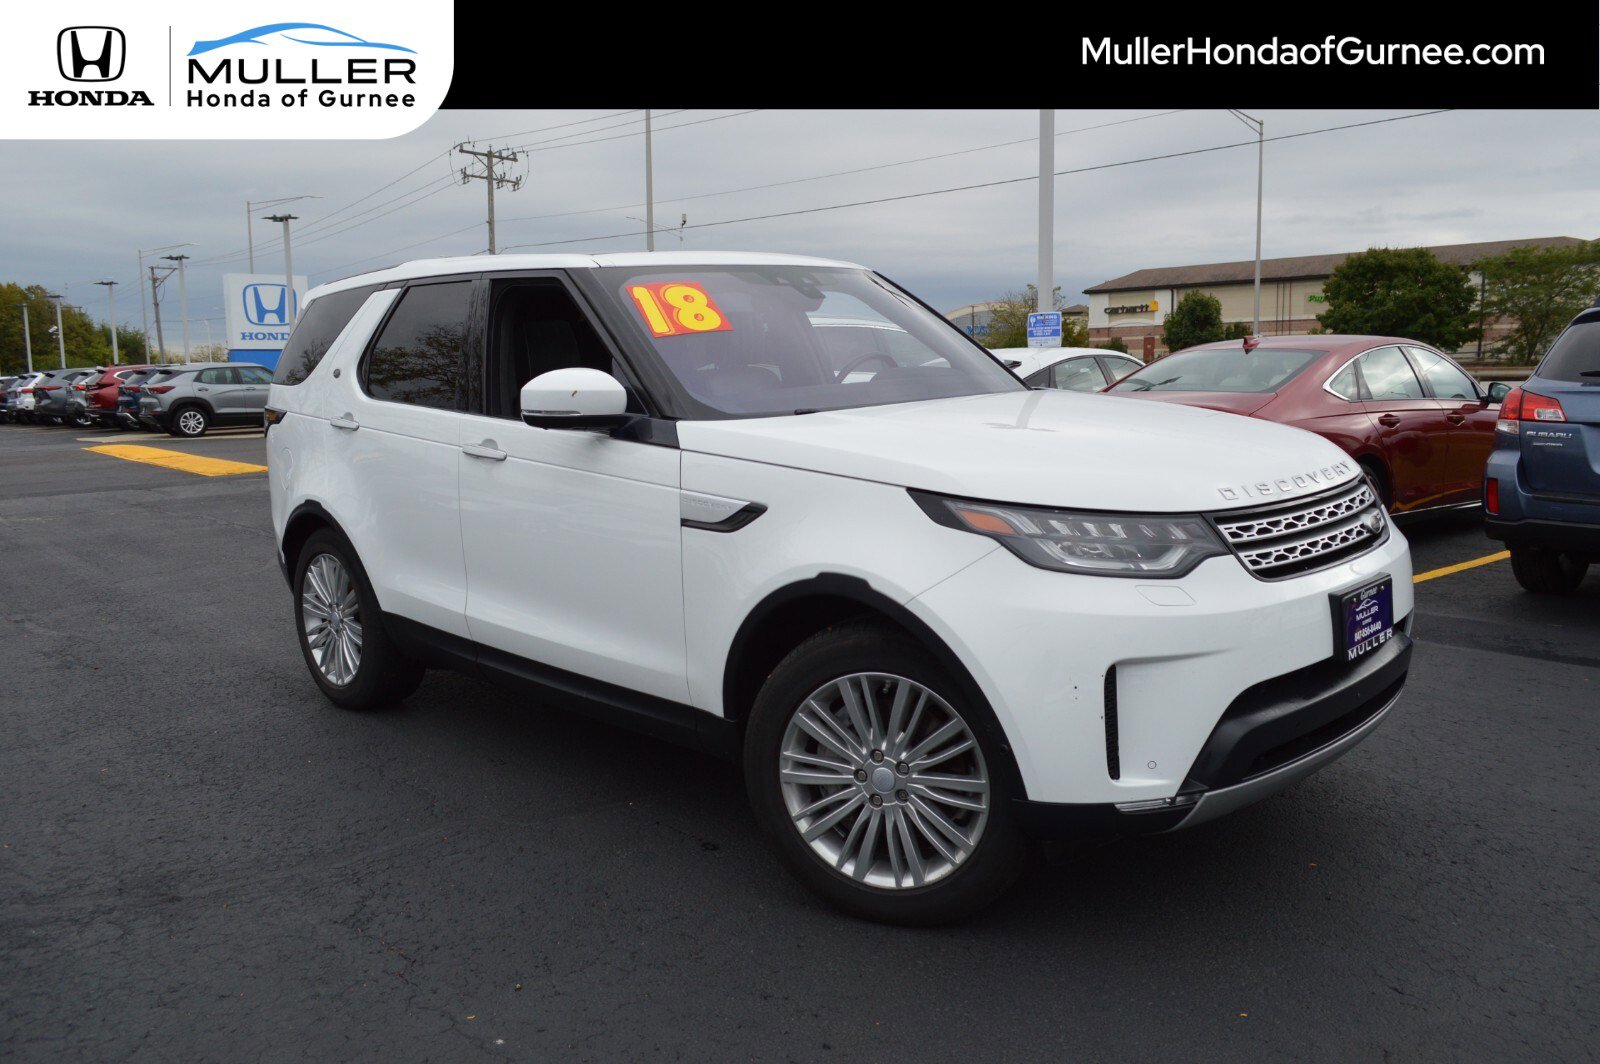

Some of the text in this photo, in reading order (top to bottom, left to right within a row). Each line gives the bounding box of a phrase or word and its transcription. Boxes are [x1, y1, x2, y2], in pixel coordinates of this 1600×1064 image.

[632, 285, 722, 335] 18
[1526, 430, 1573, 440] SUBARU
[1217, 460, 1351, 501] DISCOVERY
[1355, 605, 1379, 621] MULLER
[1347, 628, 1393, 661] MULLER
